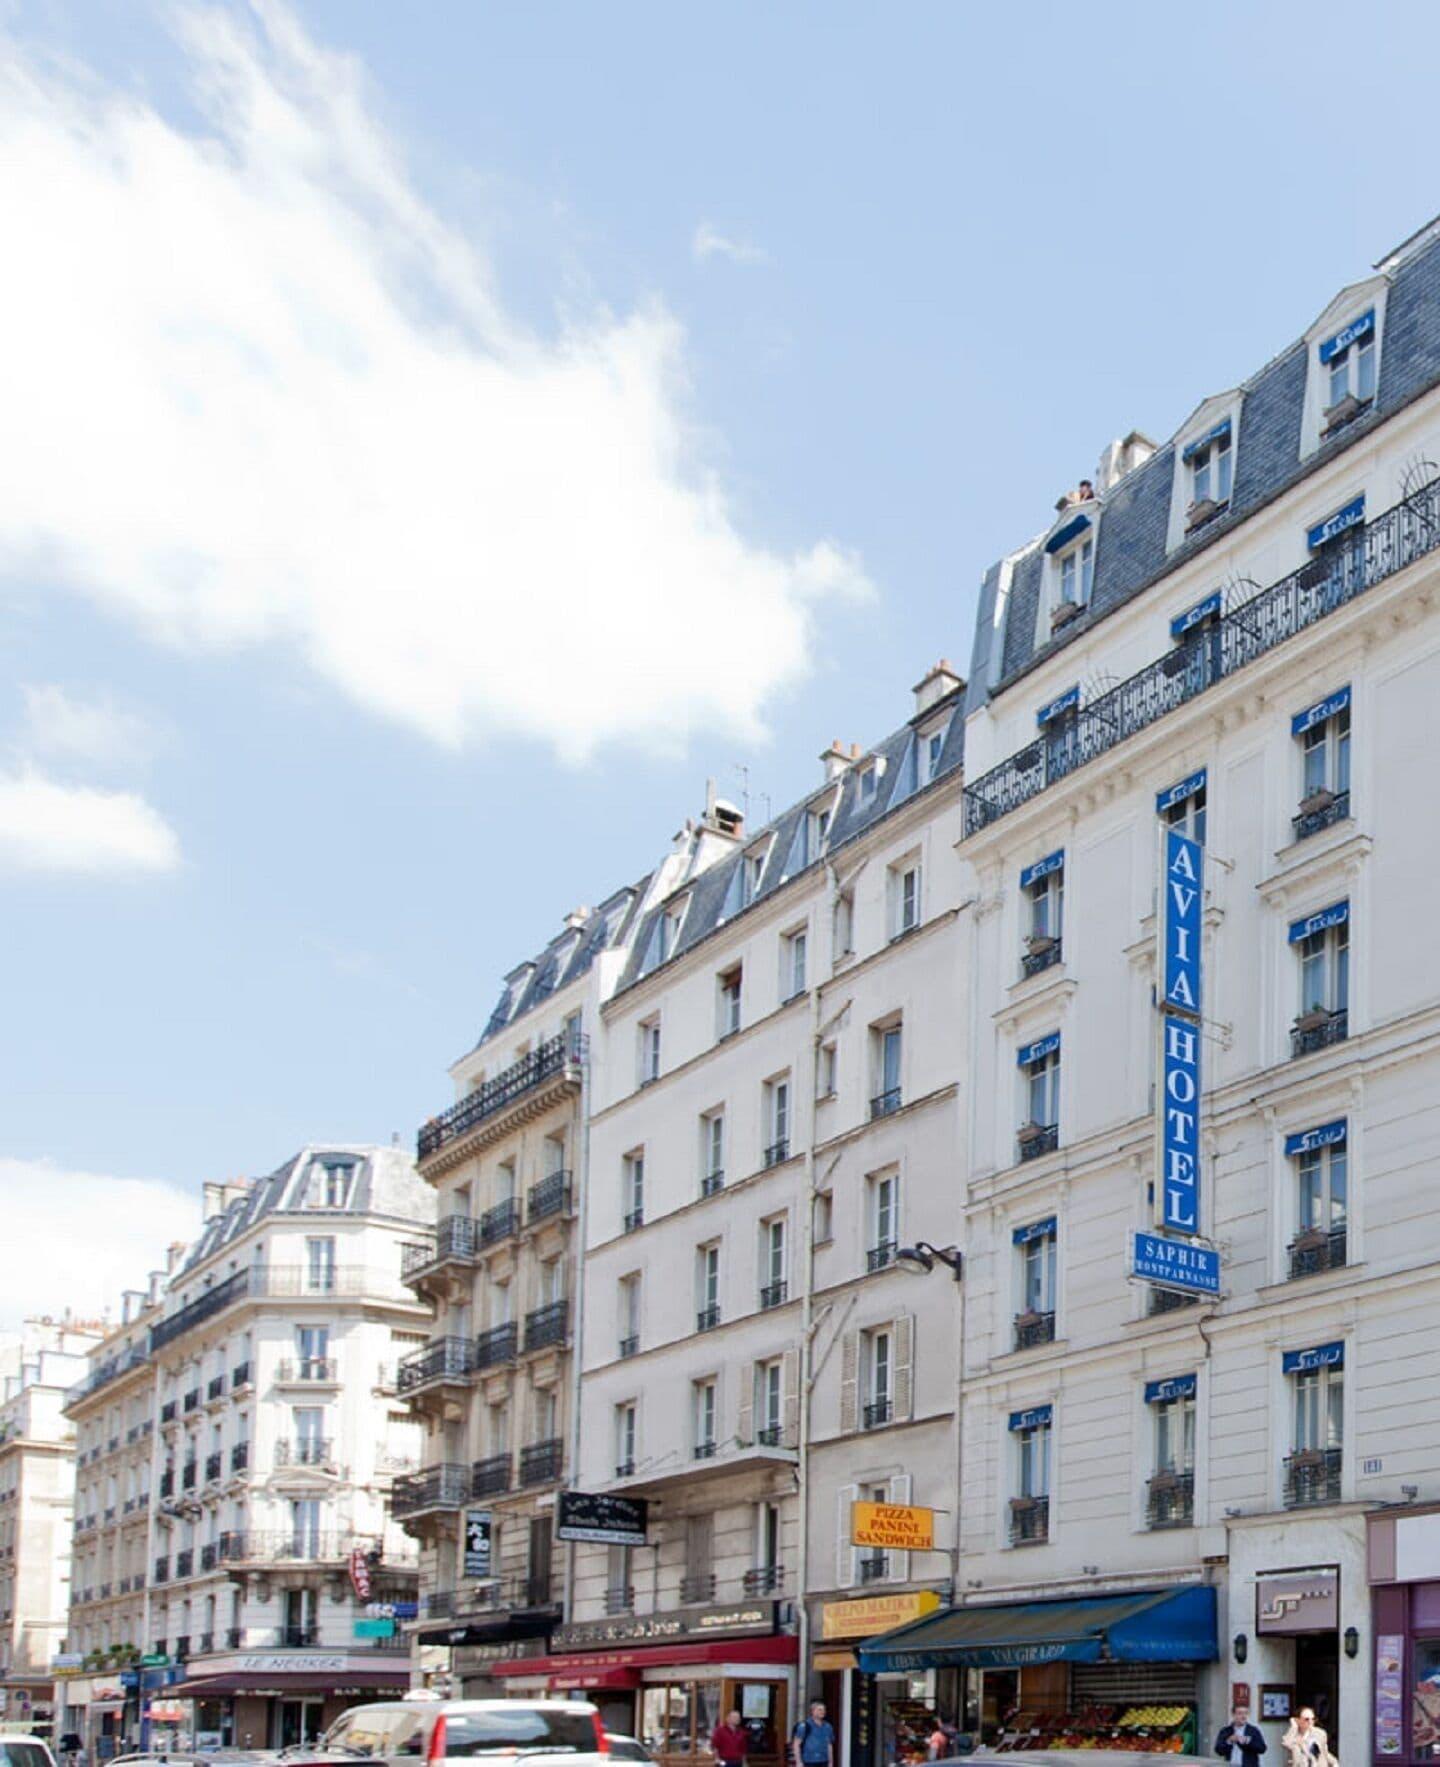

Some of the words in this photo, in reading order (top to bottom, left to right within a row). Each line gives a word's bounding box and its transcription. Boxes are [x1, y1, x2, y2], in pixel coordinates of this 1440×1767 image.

[1167, 843, 1197, 1008] AVIA
[1166, 1026, 1197, 1226] HOTEL
[1145, 1240, 1207, 1270] SAPHIR
[875, 1507, 914, 1521] PIZZA
[869, 1519, 920, 1534] PANINI
[855, 1530, 932, 1548] SANDWICH
